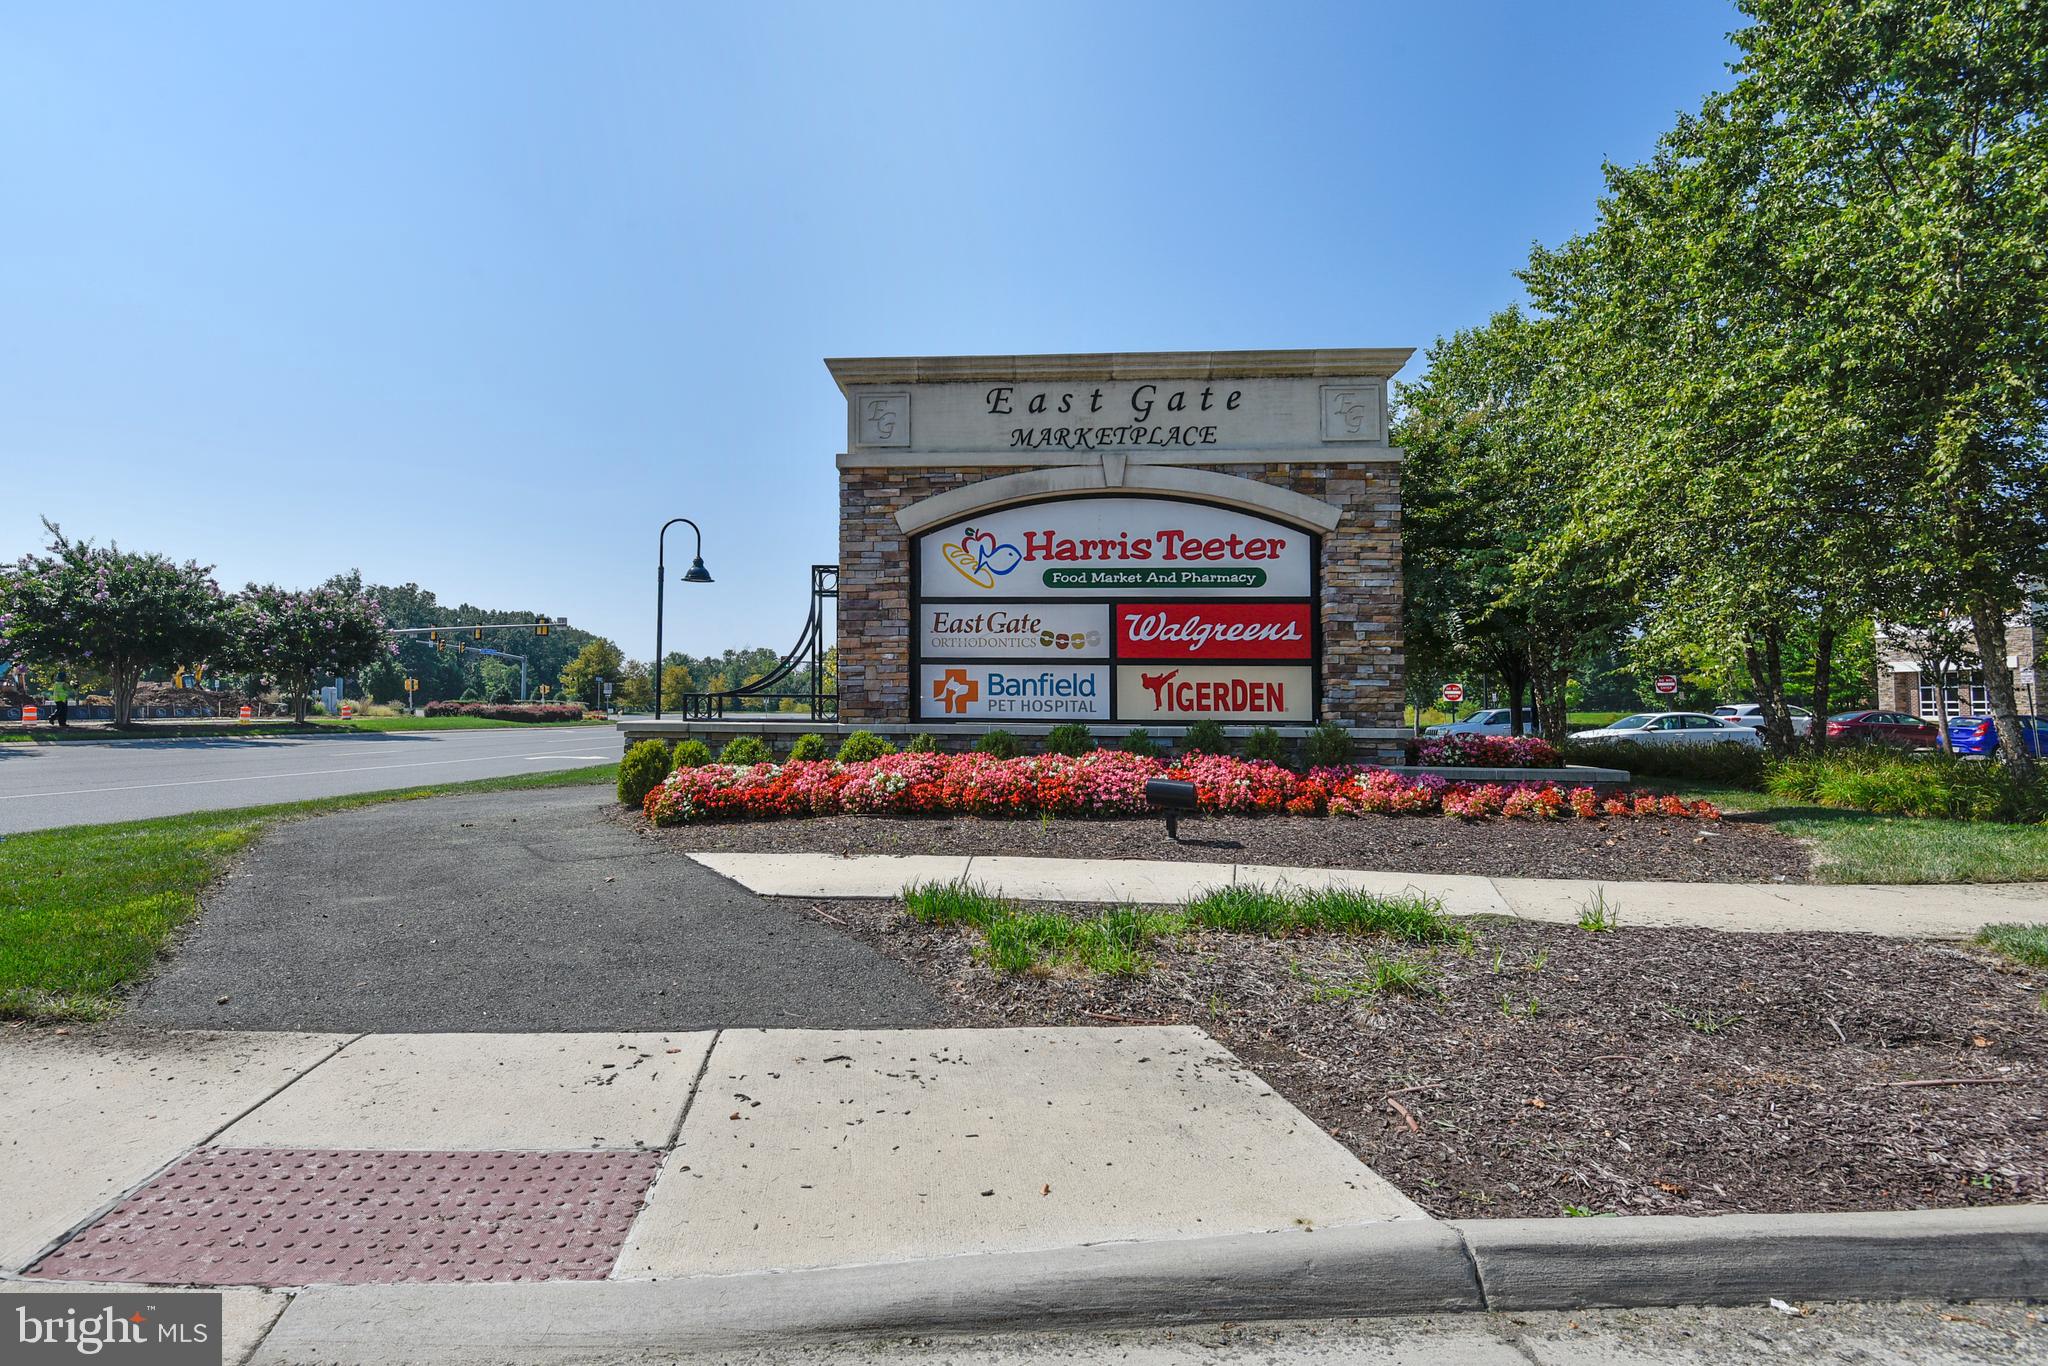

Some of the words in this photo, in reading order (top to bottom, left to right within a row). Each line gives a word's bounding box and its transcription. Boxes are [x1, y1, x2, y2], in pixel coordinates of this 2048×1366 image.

[986, 387, 1103, 414] East
[1131, 385, 1242, 423] Gate
[1010, 425, 1217, 449] MARKETPLACE
[1023, 530, 1152, 561] Harris
[1156, 529, 1286, 561] Teeter
[1053, 572, 1087, 584] Food
[1091, 572, 1142, 583] Market
[1146, 572, 1177, 583] And
[1181, 572, 1257, 586] Pharmacy
[930, 612, 984, 634] East
[987, 611, 1041, 634] Gate
[1125, 612, 1302, 651] Walgreens
[931, 637, 1037, 648] ORTHODONTICS
[988, 673, 1096, 697] Banfield
[988, 700, 1016, 712] PET
[1021, 700, 1097, 713] HOSPITAL
